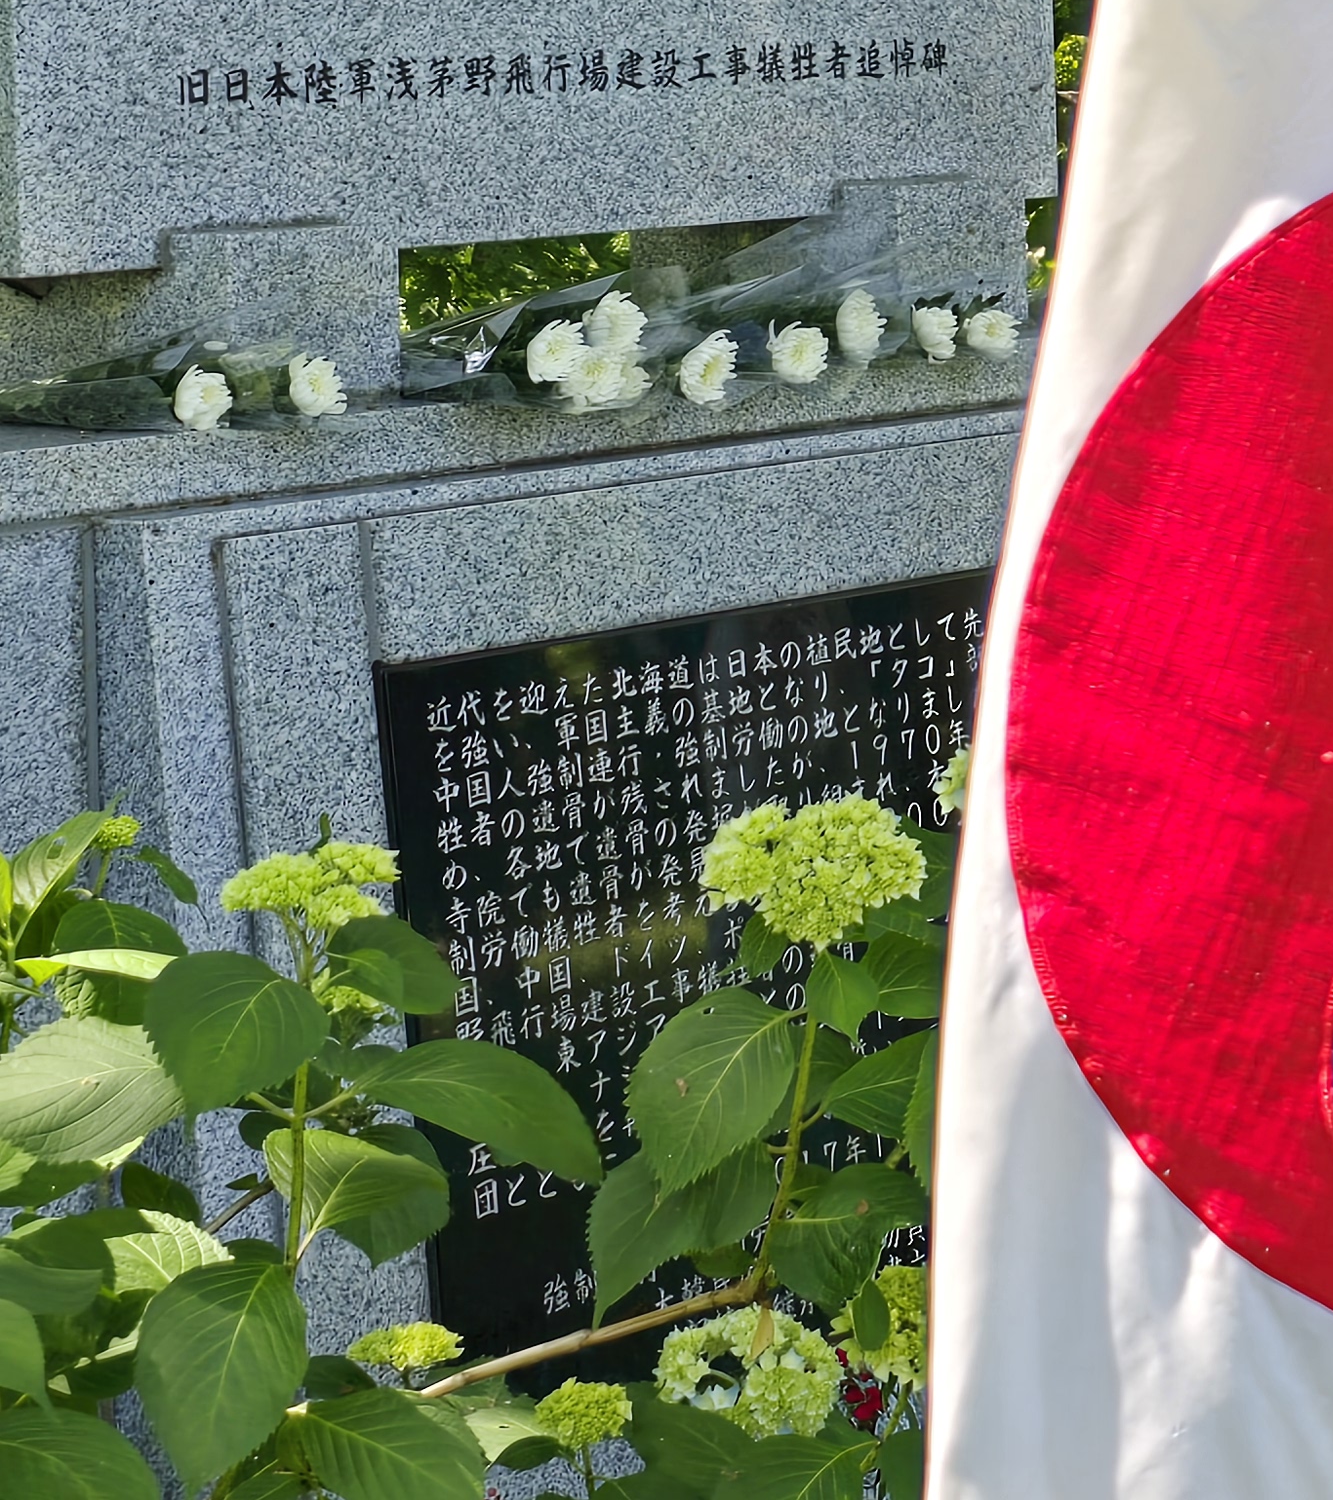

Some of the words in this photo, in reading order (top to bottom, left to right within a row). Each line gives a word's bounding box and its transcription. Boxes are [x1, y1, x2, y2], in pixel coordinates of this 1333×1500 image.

[178, 38, 949, 107] 旧日本陸軍浅茅野飛行場建設工事犠牲者追悼碑
